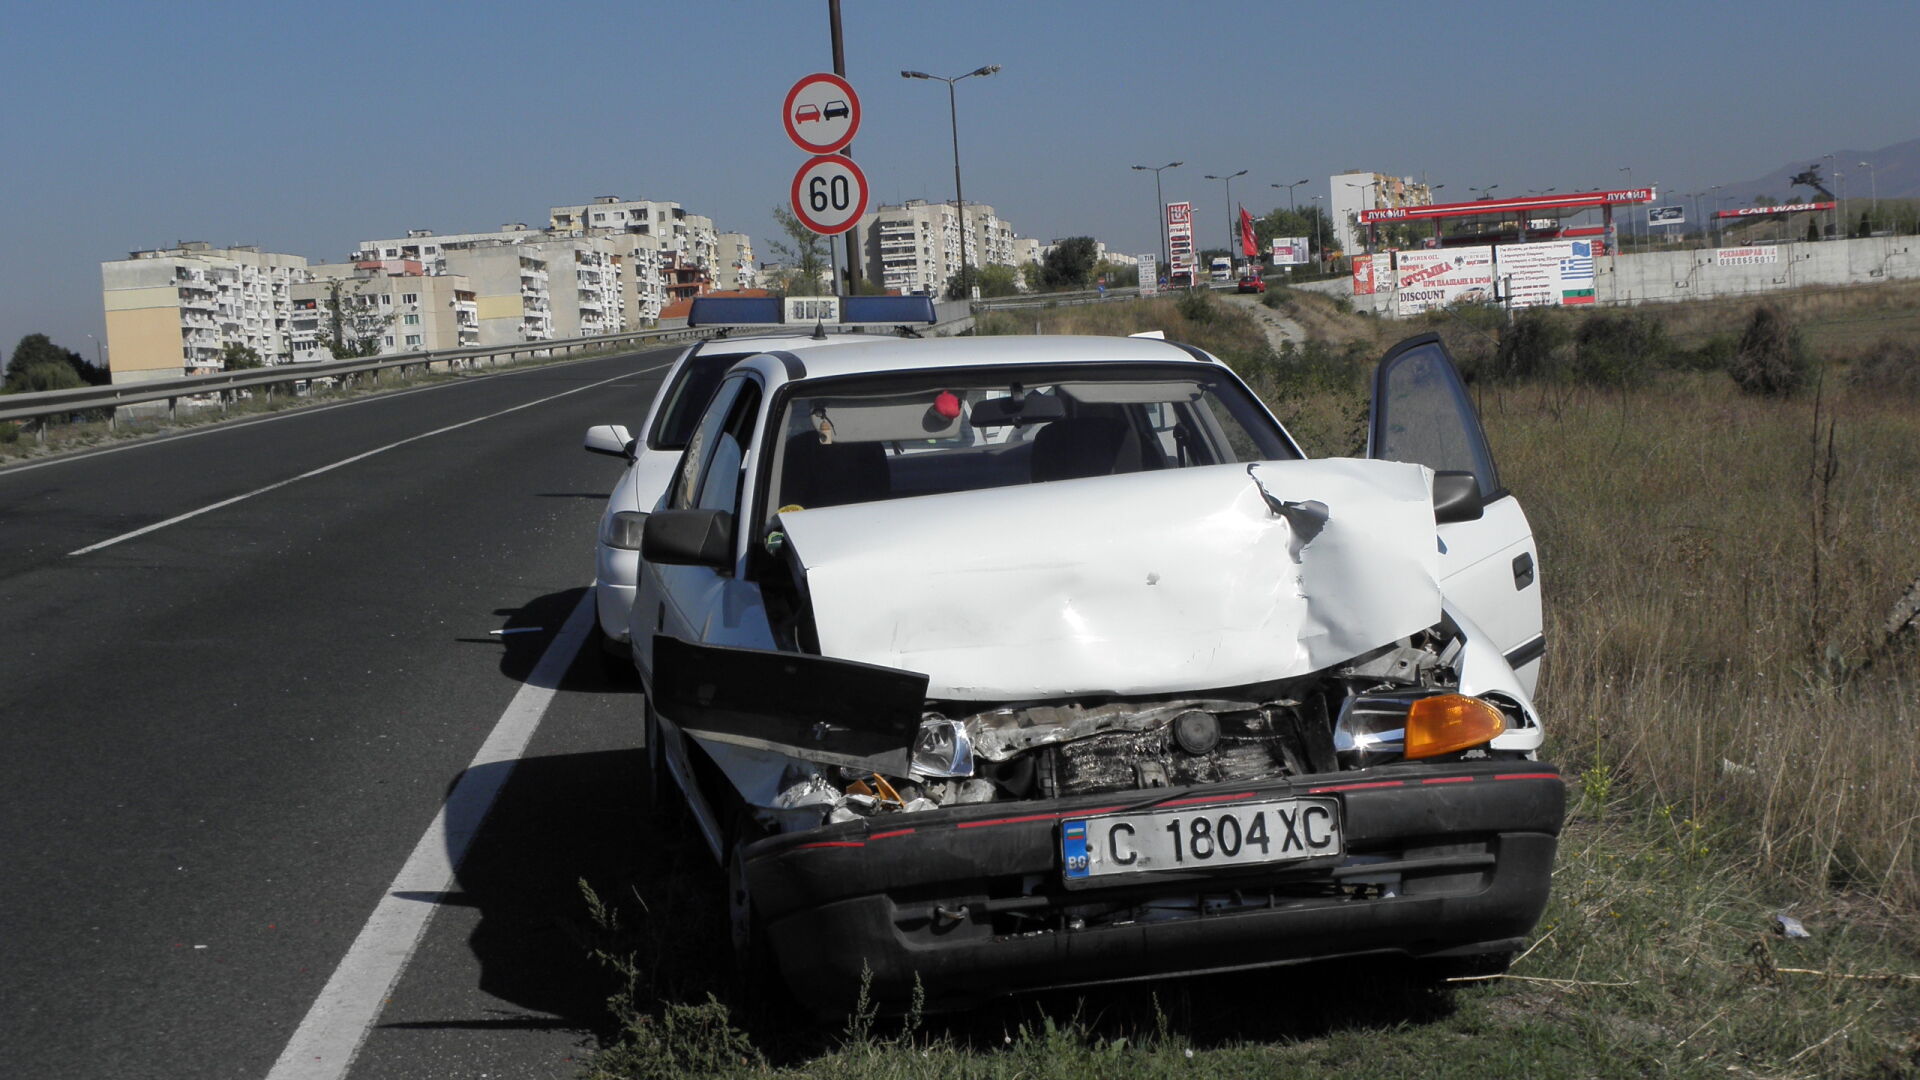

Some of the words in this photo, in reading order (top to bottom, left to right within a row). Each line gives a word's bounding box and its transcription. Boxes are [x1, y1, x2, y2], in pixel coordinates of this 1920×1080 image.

[810, 175, 849, 212] 60
[1738, 207, 1769, 215] CAR
[1772, 203, 1816, 212] WASH
[1400, 290, 1445, 302] DISCOUNT
[1109, 823, 1137, 865] C
